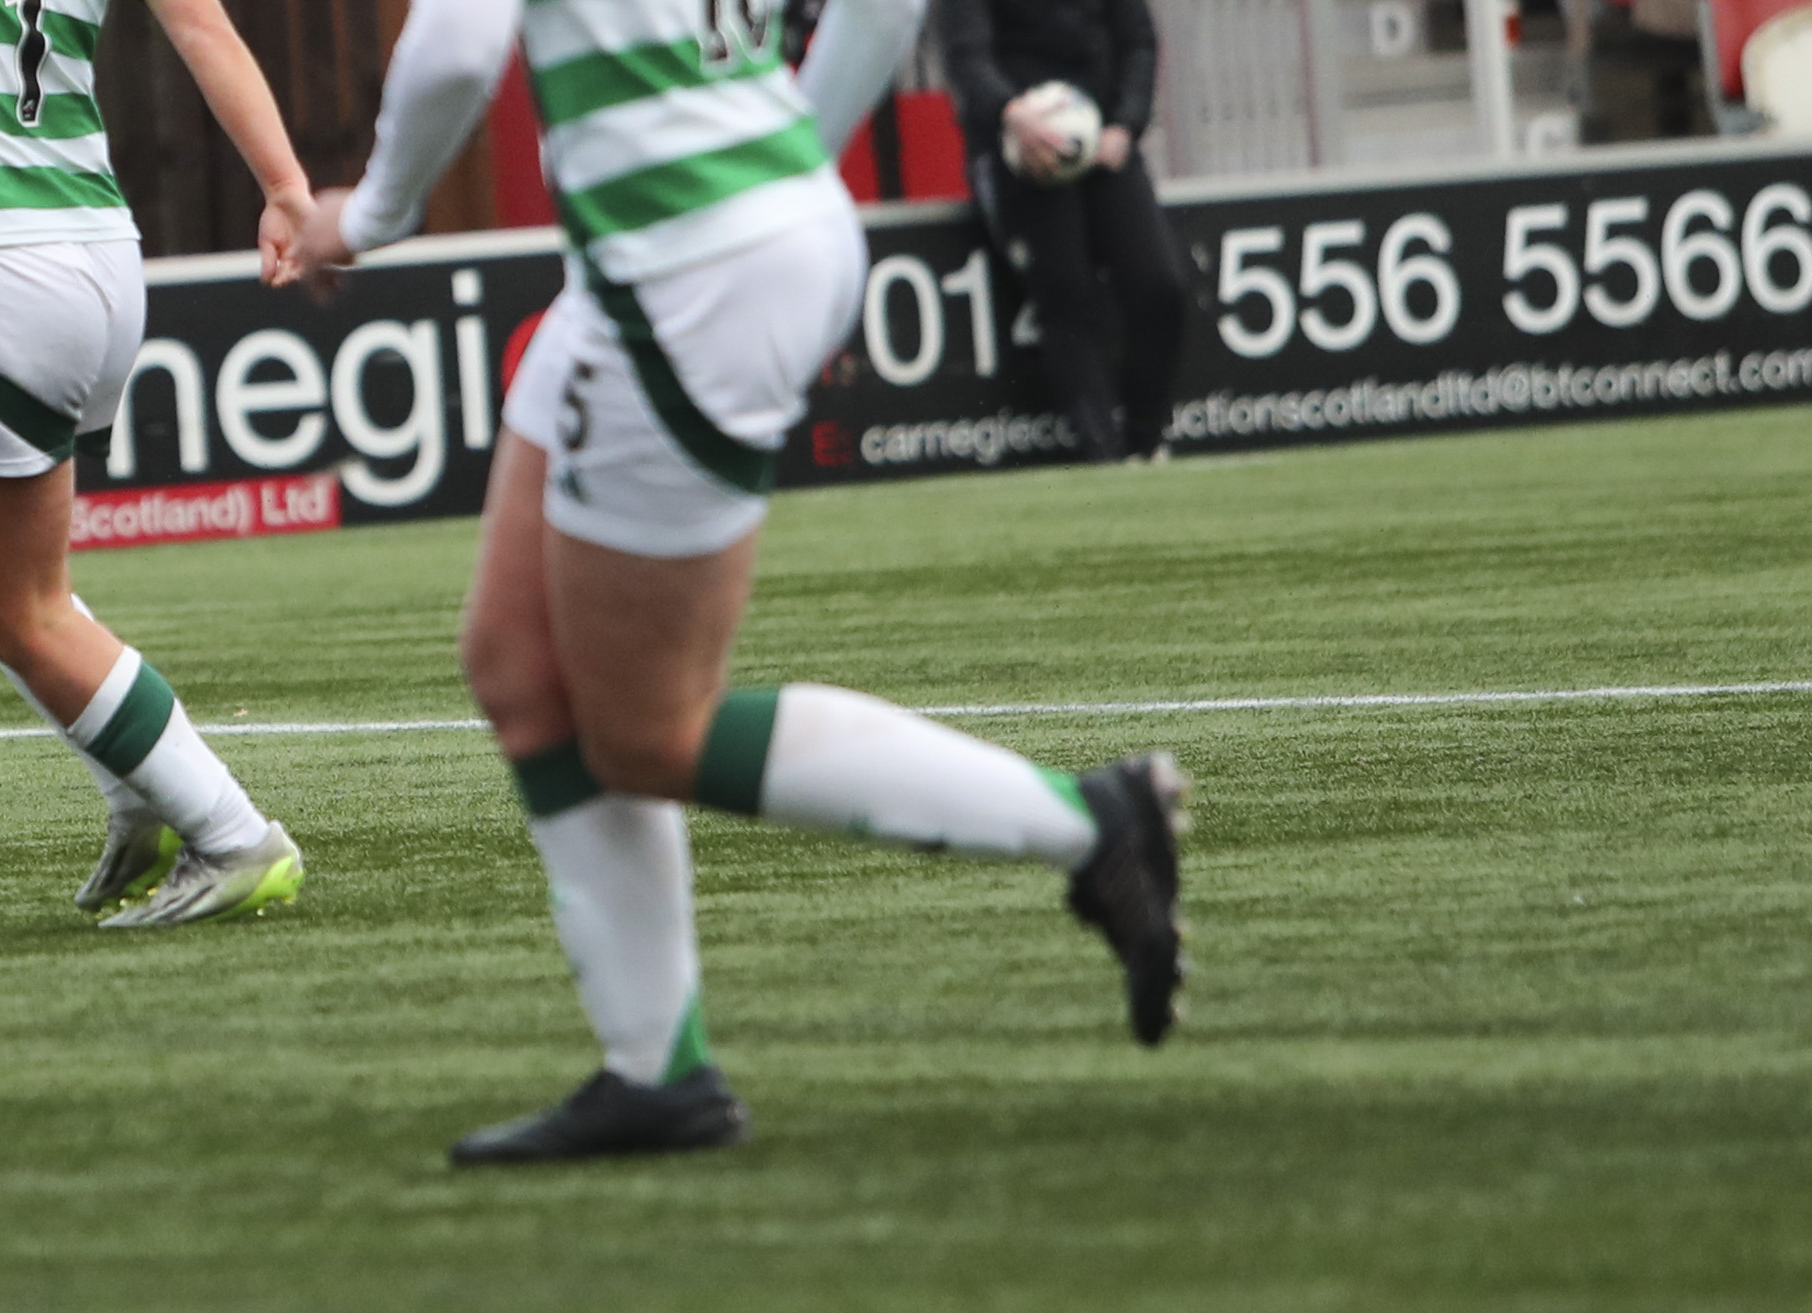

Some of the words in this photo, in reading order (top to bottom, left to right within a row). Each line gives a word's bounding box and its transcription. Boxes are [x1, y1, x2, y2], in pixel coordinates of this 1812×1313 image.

[1216, 215, 1461, 360] 556
[1502, 182, 1812, 335] 5566
[71, 484, 252, 544] Scotland)
[260, 473, 338, 526] Ltd
